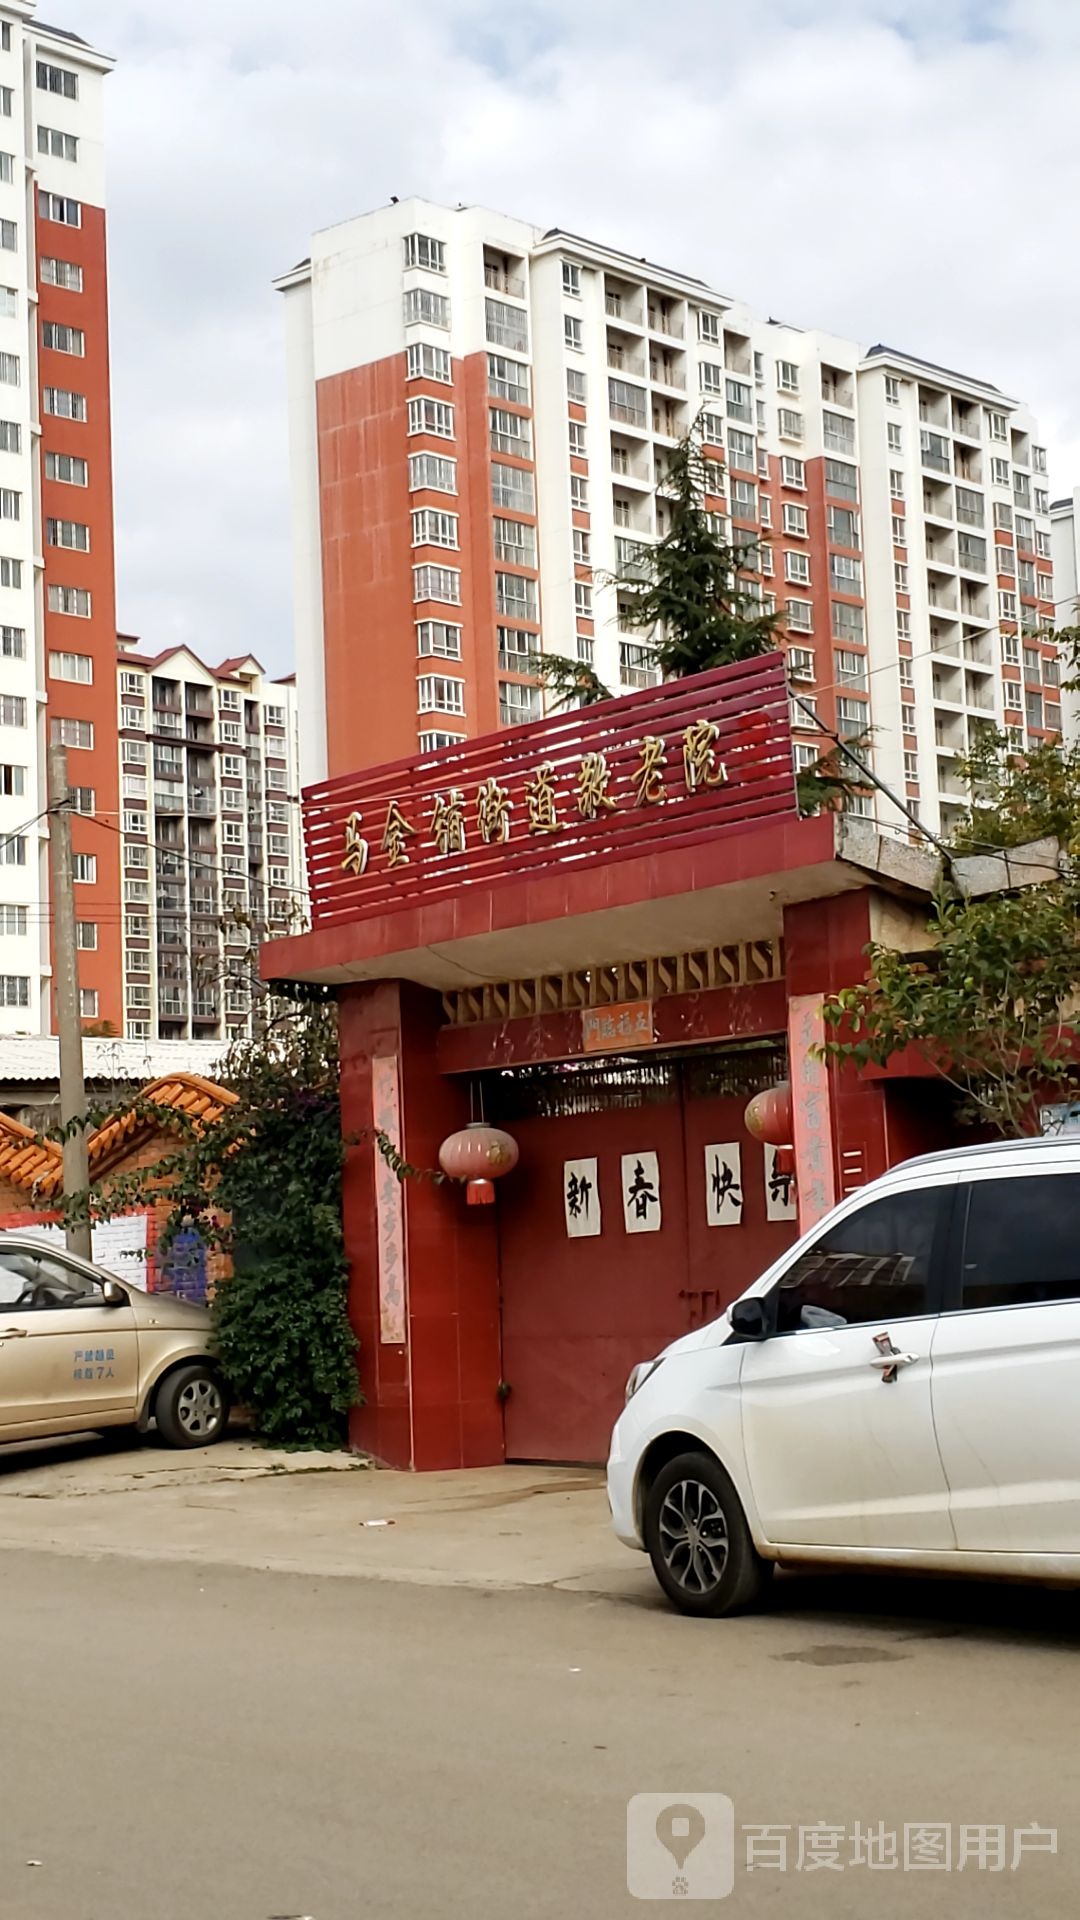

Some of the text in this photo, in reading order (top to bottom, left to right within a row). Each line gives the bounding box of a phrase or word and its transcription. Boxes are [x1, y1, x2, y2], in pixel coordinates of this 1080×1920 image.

[340, 719, 729, 876] 马金铺街道敬老院
